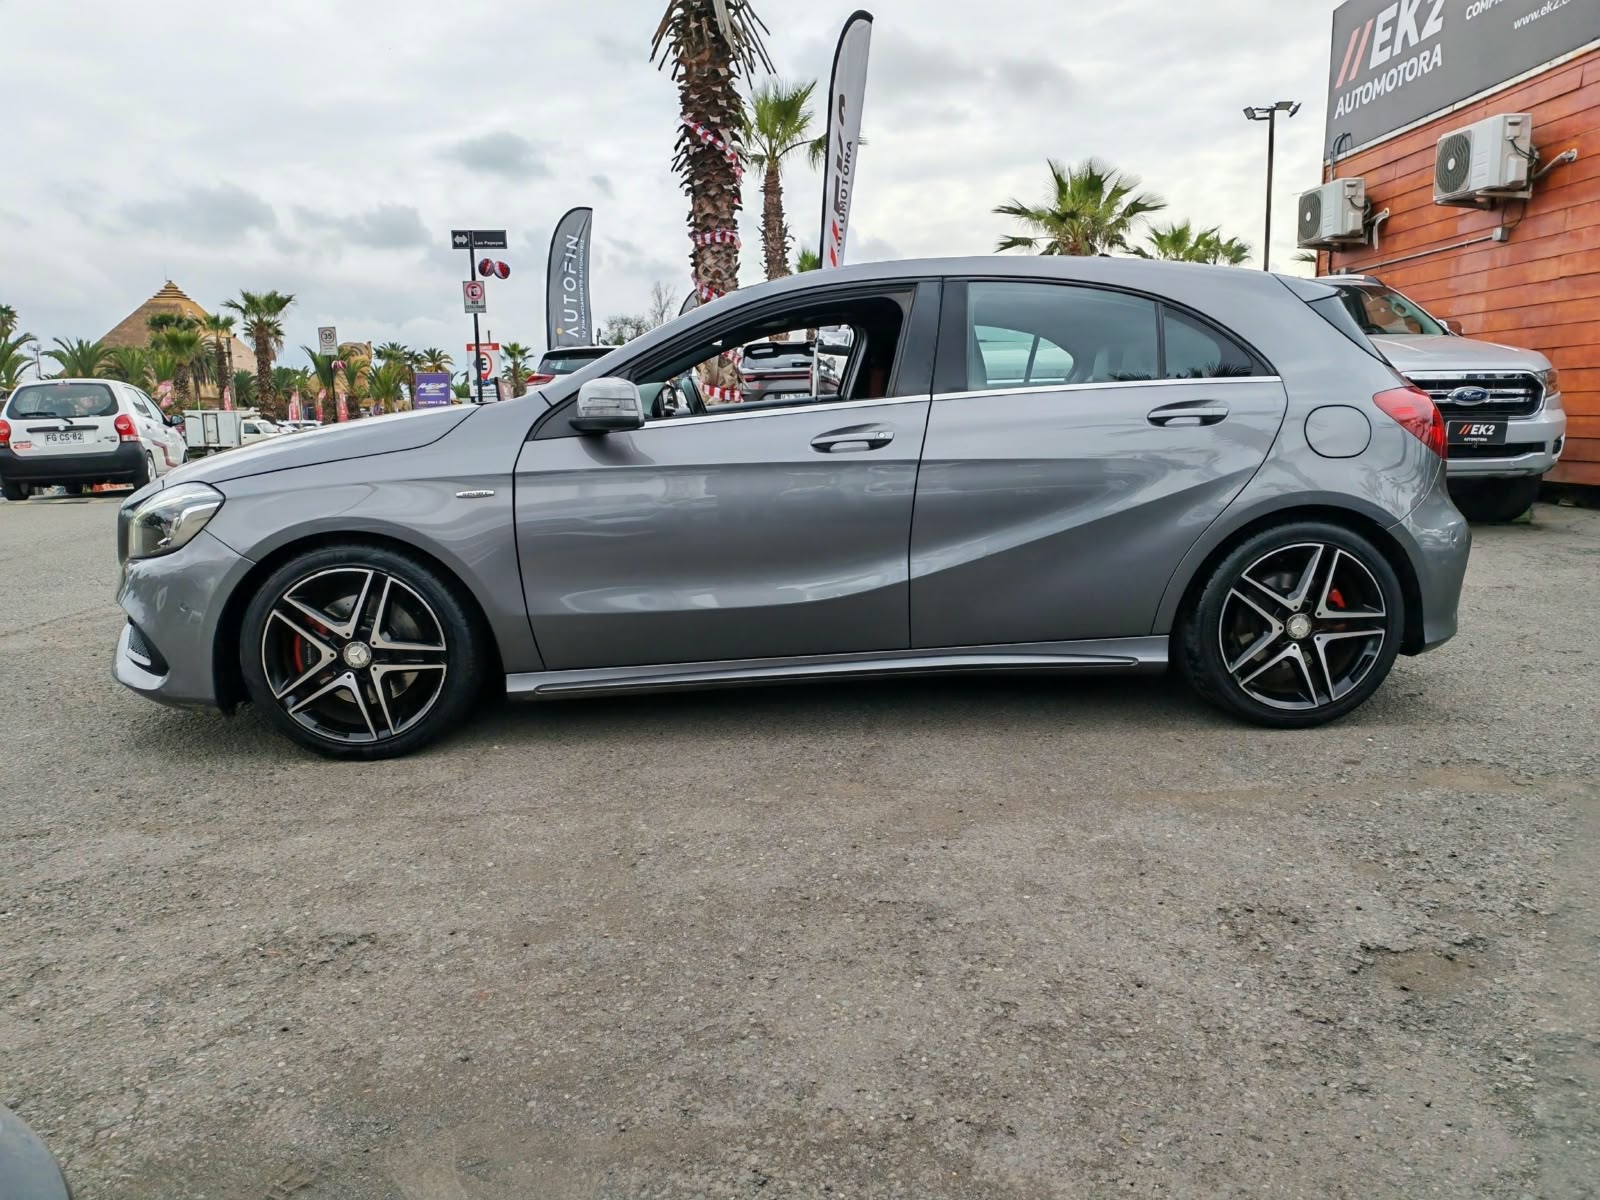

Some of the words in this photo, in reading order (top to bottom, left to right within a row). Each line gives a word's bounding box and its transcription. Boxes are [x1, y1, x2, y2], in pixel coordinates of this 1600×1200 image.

[1465, 0, 1504, 20] COMP
[1334, 43, 1443, 120] AUTOMOTORA
[563, 234, 579, 338] AUTOFIN
[1462, 390, 1482, 400] Ford
[46, 434, 57, 442] FG
